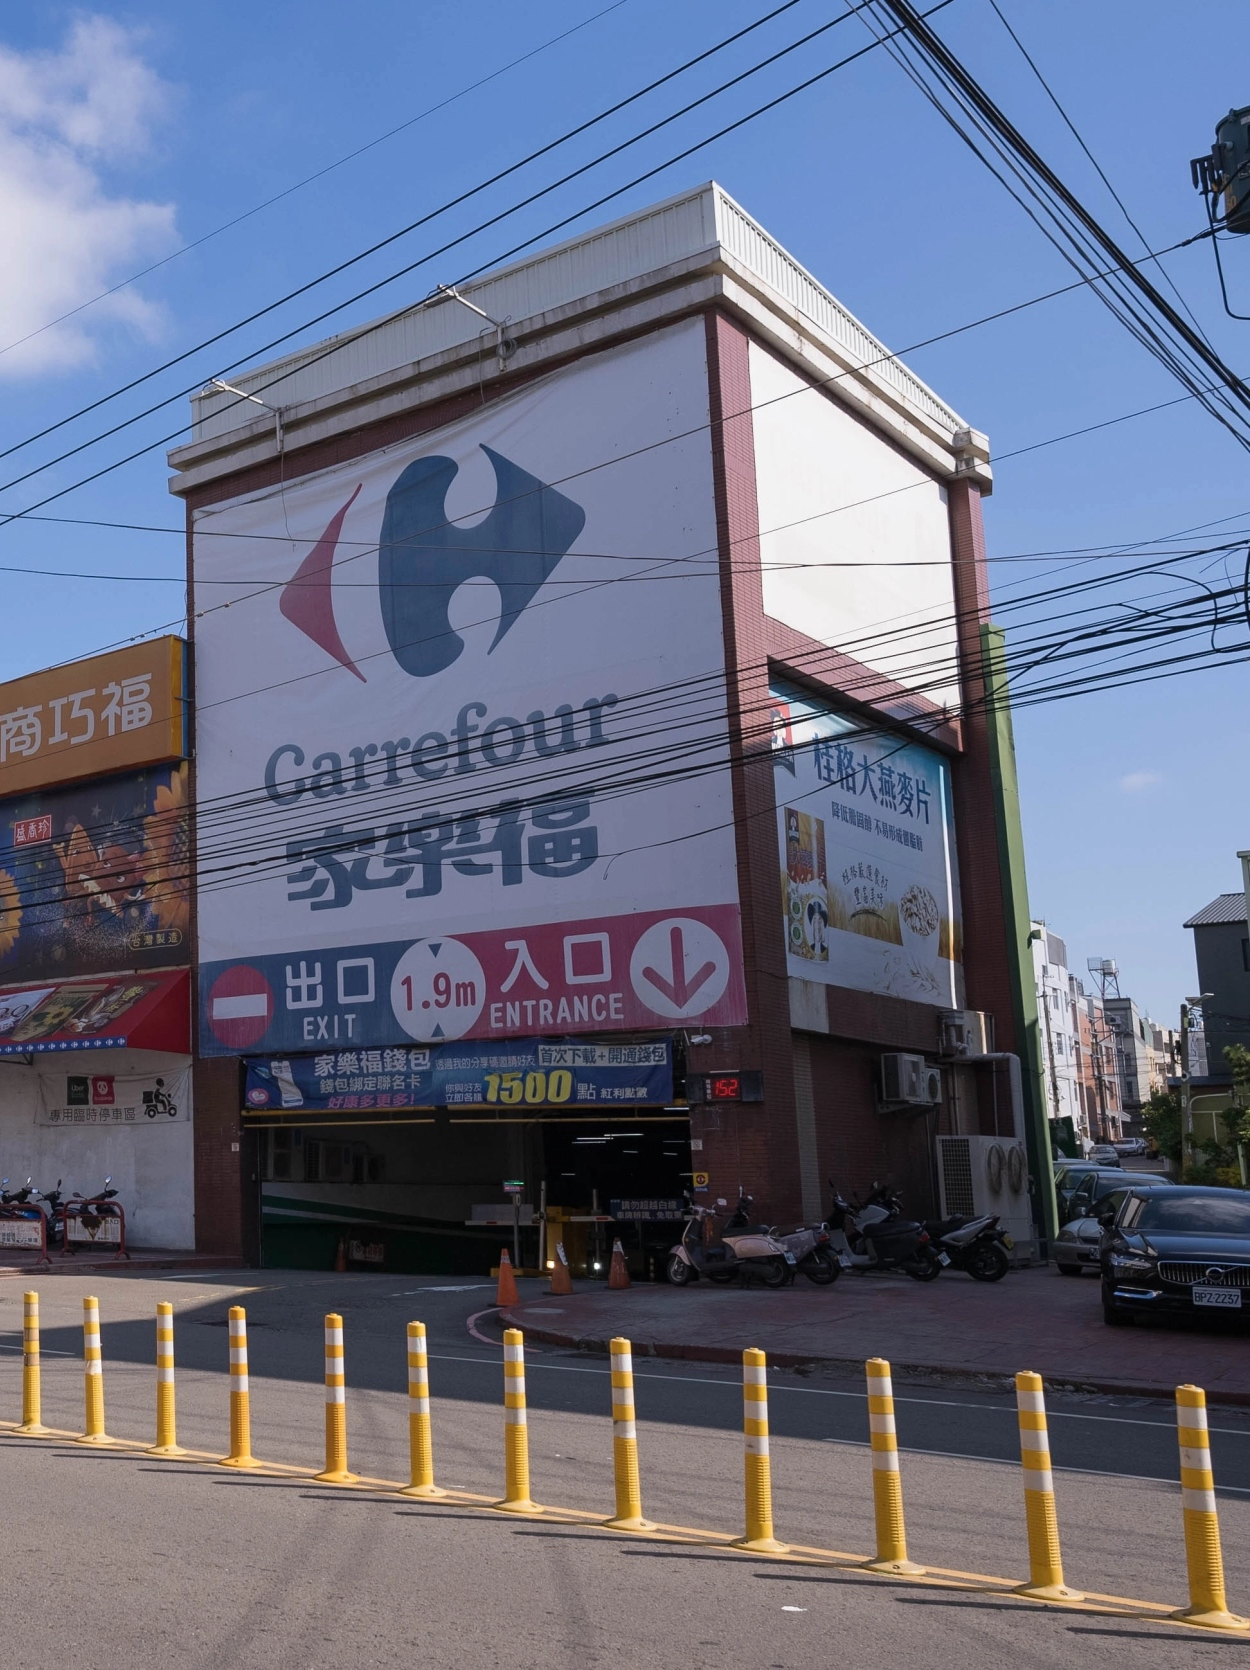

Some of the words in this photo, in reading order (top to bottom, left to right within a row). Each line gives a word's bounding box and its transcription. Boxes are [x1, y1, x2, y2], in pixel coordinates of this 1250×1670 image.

[264, 693, 619, 807] Carrefour
[812, 733, 931, 825] 桂格大燕麥片
[16, 819, 49, 842] 盛香珍
[831, 801, 872, 833] 降低膽固醇
[286, 786, 599, 912] 家樂福
[132, 932, 178, 947] 台灣製造
[500, 932, 612, 993] 入口
[286, 957, 375, 1010] 出口
[401, 972, 476, 1012] 1.9m
[490, 992, 624, 1029] ENTRANCE
[303, 1014, 357, 1040] EXIT
[314, 1048, 431, 1078] 家樂福錢包
[320, 1075, 421, 1095] 錢包綁定聯名卡
[484, 1069, 573, 1104] 1500
[577, 1082, 596, 1100] 點
[601, 1086, 648, 1100] 紅利點數
[715, 1079, 738, 1096] 152
[49, 1107, 136, 1122] 專用臨時停車區
[328, 1093, 415, 1109] 好康多更多!
[1194, 1292, 1240, 1305] BPZ-2237
